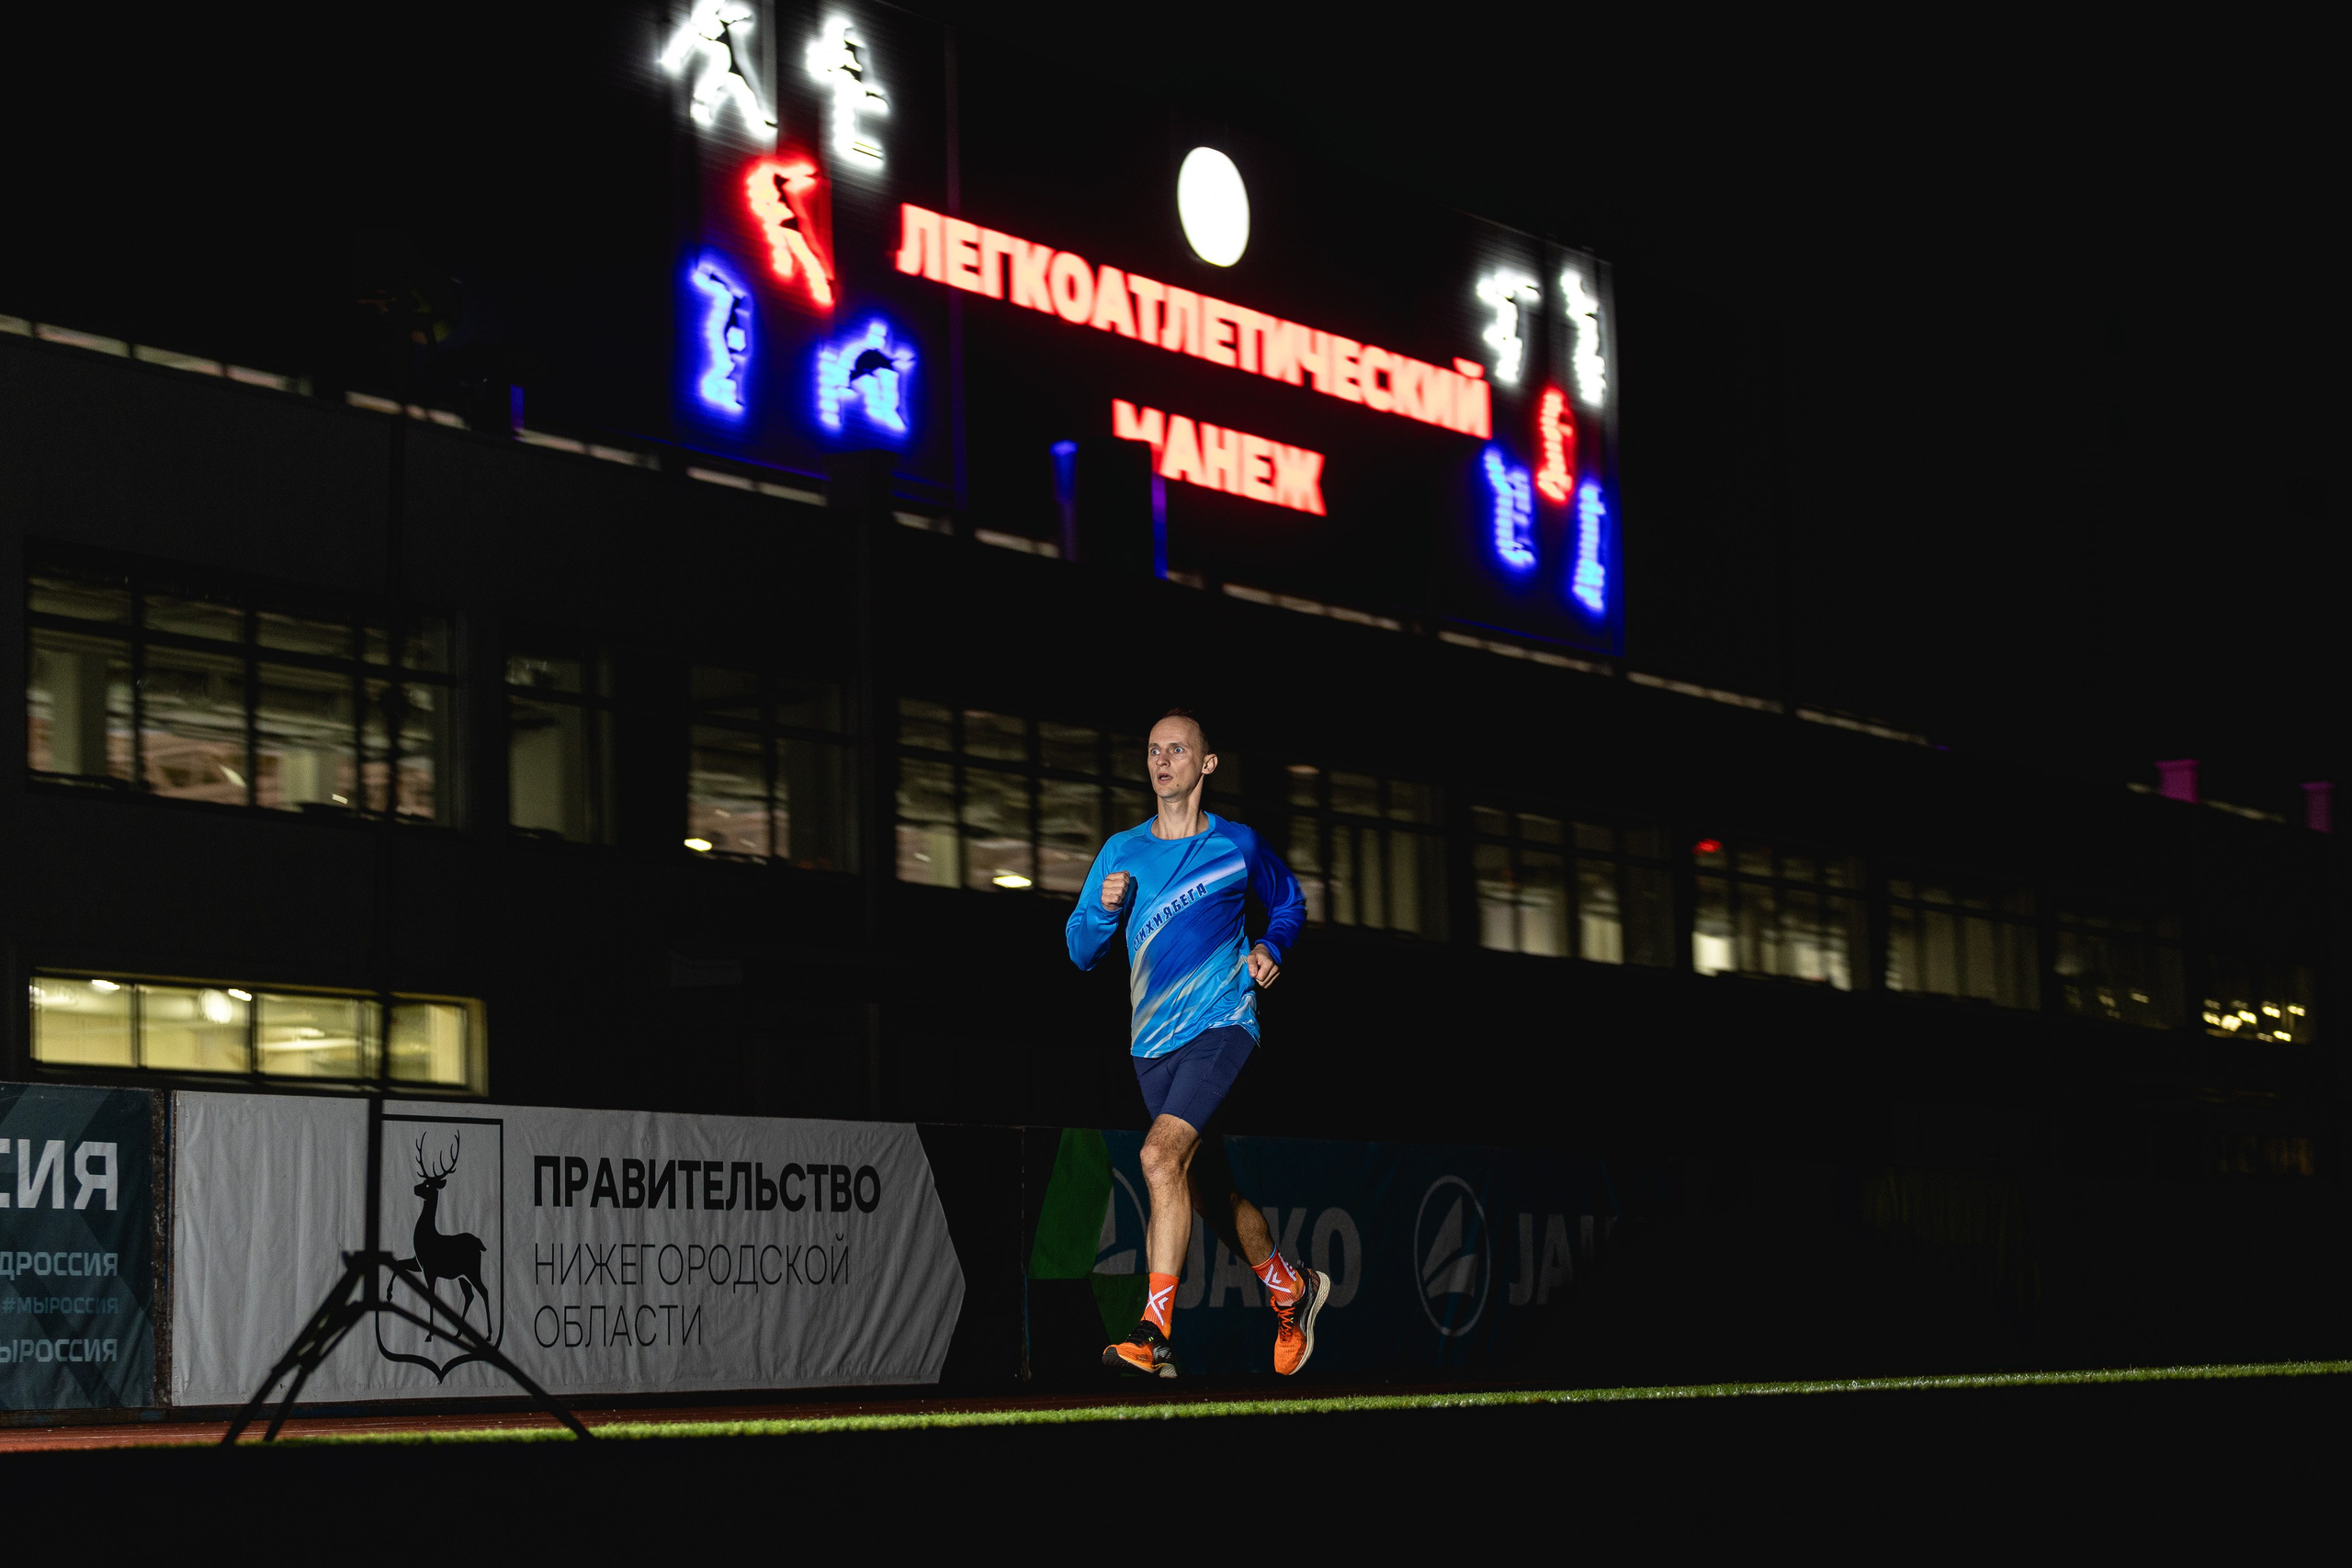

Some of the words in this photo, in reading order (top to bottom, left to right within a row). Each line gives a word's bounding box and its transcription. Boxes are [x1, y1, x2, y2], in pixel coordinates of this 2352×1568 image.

[895, 202, 1492, 439] ЛЕГКОАТЛЕТИЧЕСКИЙ
[0, 1138, 119, 1212] ИЯ
[534, 1155, 881, 1213] ПРАВИТЕЛЬСТВО
[535, 1233, 849, 1293] НИЖЕГОРОДСКОЙ
[2, 1296, 119, 1314] #МЫРОССИЯ
[534, 1304, 701, 1348] ОБЛАСТИ
